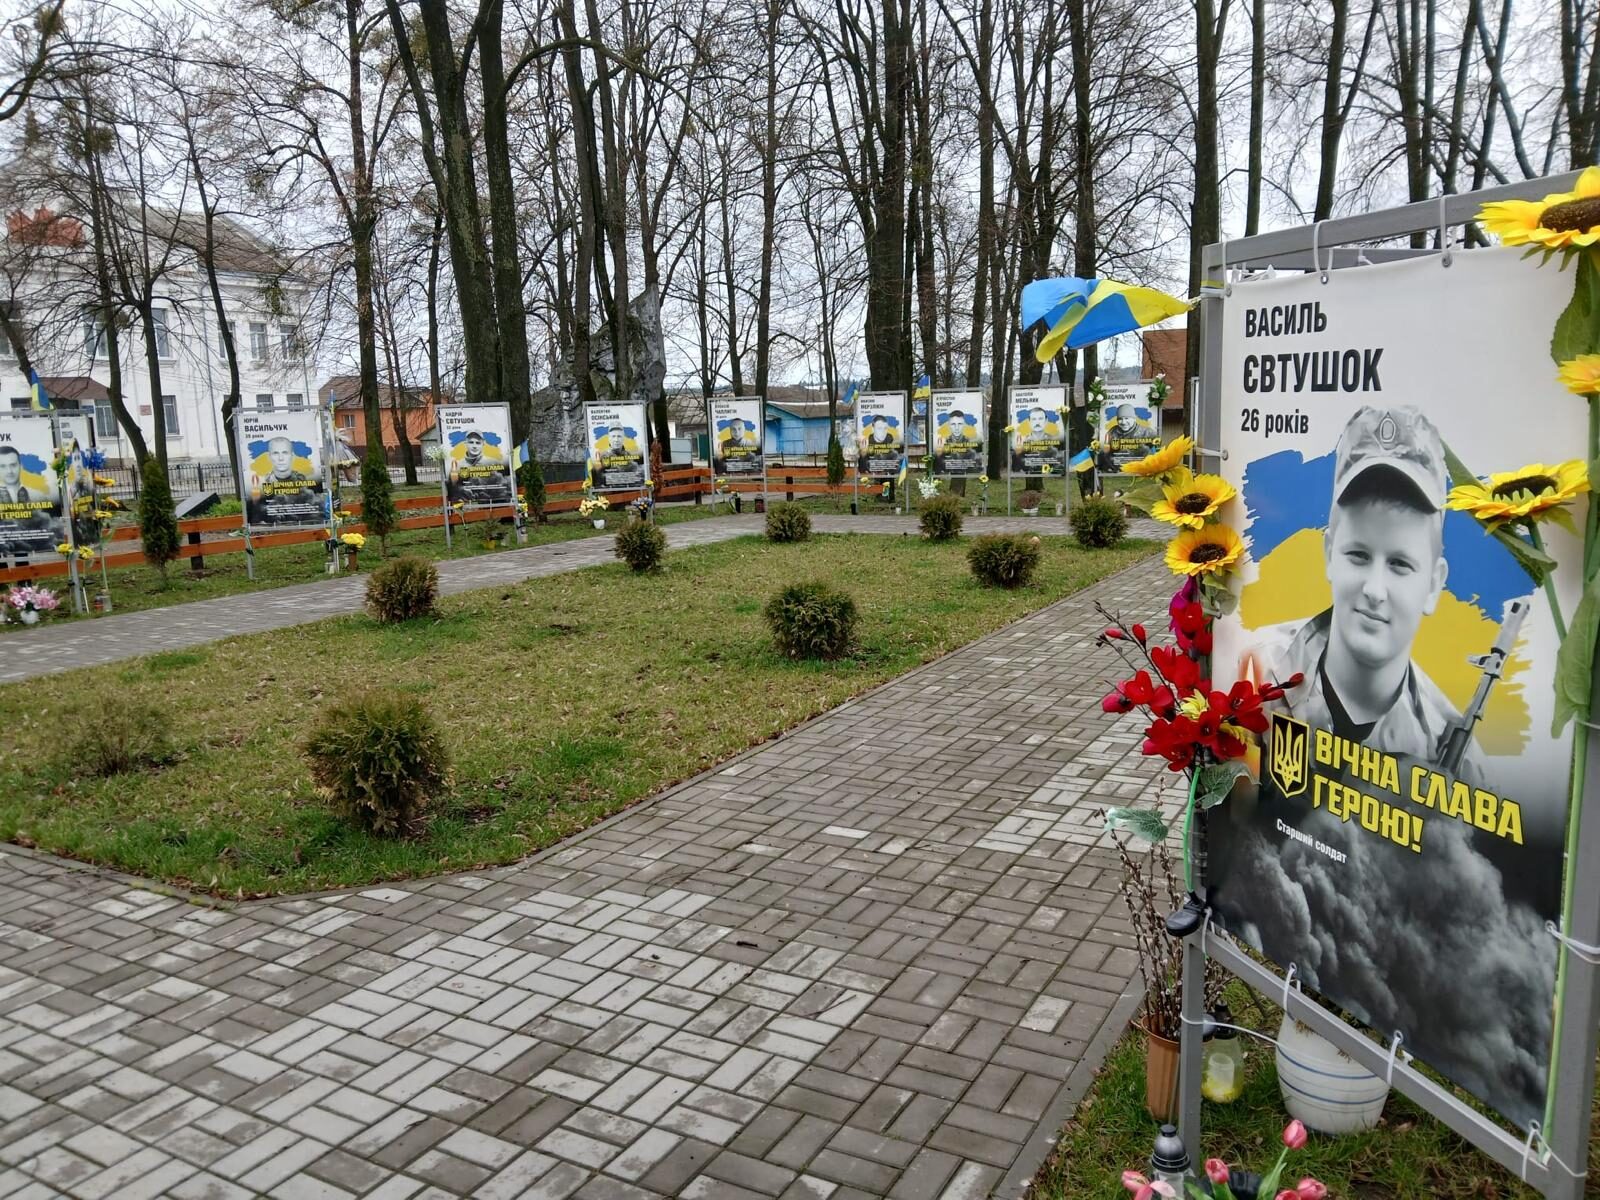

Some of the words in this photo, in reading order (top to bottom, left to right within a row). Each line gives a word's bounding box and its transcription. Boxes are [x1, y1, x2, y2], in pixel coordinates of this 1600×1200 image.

[1245, 301, 1327, 338] ВАСИЛЬ
[1242, 347, 1384, 394] ЄВТУШОК
[244, 424, 288, 432] ВАСИЛЬЧУК
[1240, 407, 1260, 434] 26
[1264, 408, 1310, 438] років
[273, 480, 294, 488] ВІЧНА
[273, 488, 300, 496] ГЕРОЮ!
[0, 511, 32, 519] ГЕРОЮ!
[26, 501, 53, 509] СЛАВА
[1314, 728, 1401, 795] ВІЧНА
[1410, 765, 1525, 846] СЛАВА
[1312, 774, 1425, 854] ГЕРОЮ!
[1276, 817, 1314, 849] Старший
[1314, 840, 1348, 864] солдат
